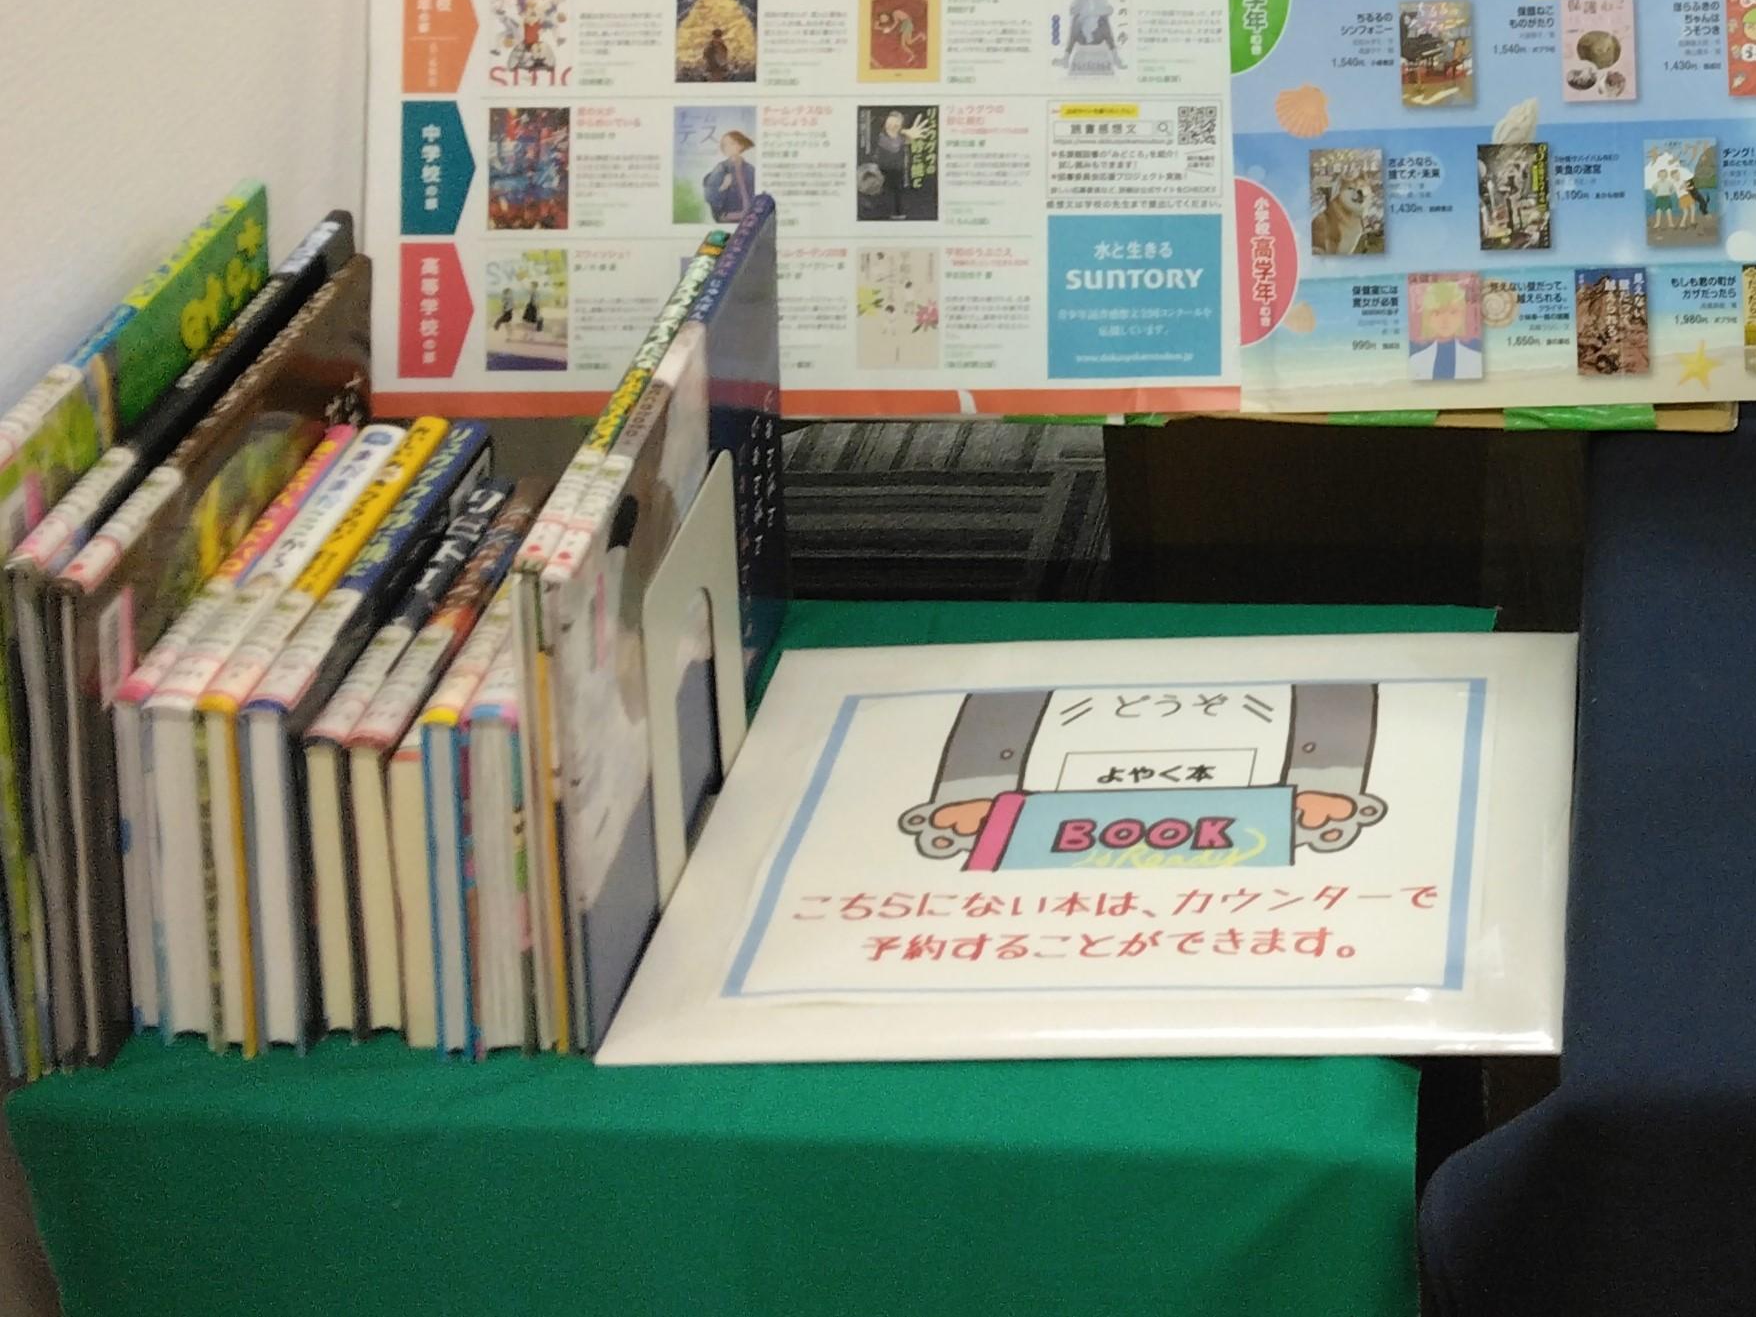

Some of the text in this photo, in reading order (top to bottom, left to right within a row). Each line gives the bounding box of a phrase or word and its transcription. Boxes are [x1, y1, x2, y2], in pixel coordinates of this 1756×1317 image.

[1093, 240, 1173, 261] 水と生きる
[1065, 268, 1205, 291] SUNTORY
[1112, 690, 1230, 720] どうぞ
[1096, 760, 1218, 786] よやく本
[1049, 817, 1237, 855] BOOK
[790, 883, 1443, 923] こちらにない本は、カウンターで
[861, 926, 1361, 963] 予約することができます。
